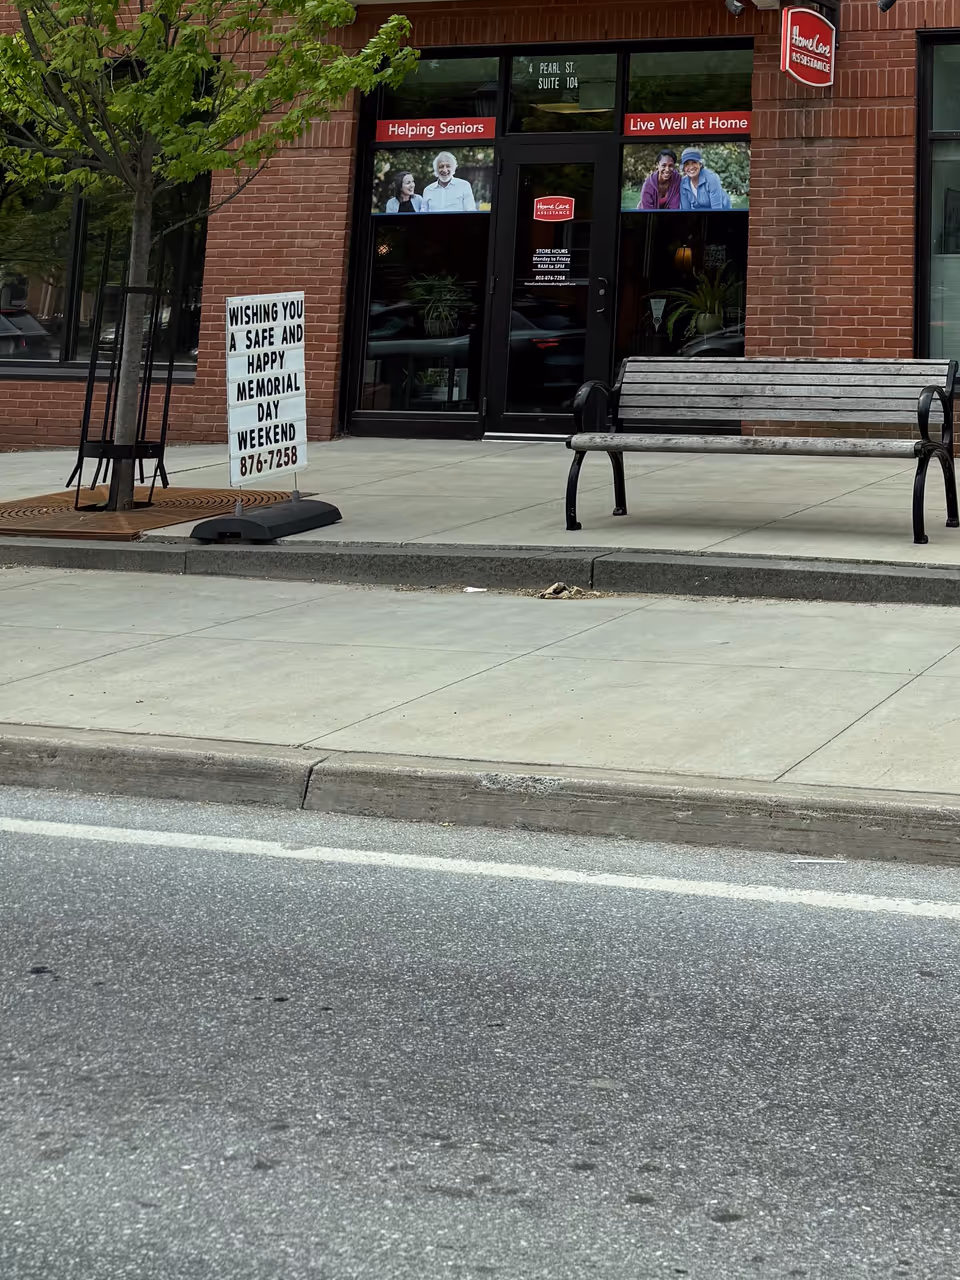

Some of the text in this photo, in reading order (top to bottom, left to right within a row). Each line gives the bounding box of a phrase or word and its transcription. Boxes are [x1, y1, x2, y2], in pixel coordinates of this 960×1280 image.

[791, 25, 831, 57] Home Care
[528, 62, 575, 74] 4 PEARL ST.
[791, 52, 830, 73] ASSISTANCE
[538, 77, 578, 89] SUITE 104
[388, 121, 485, 138] Helping Seniors
[630, 116, 748, 131] Live Well at Home
[229, 300, 303, 326] WISHING YOU
[229, 324, 303, 352] A SAFE AND
[247, 350, 285, 374] HAPPY
[236, 373, 300, 402] MEMORIAL
[257, 400, 280, 422] DAY
[237, 423, 296, 451] WEEKEND
[240, 446, 298, 477] 876-7258
